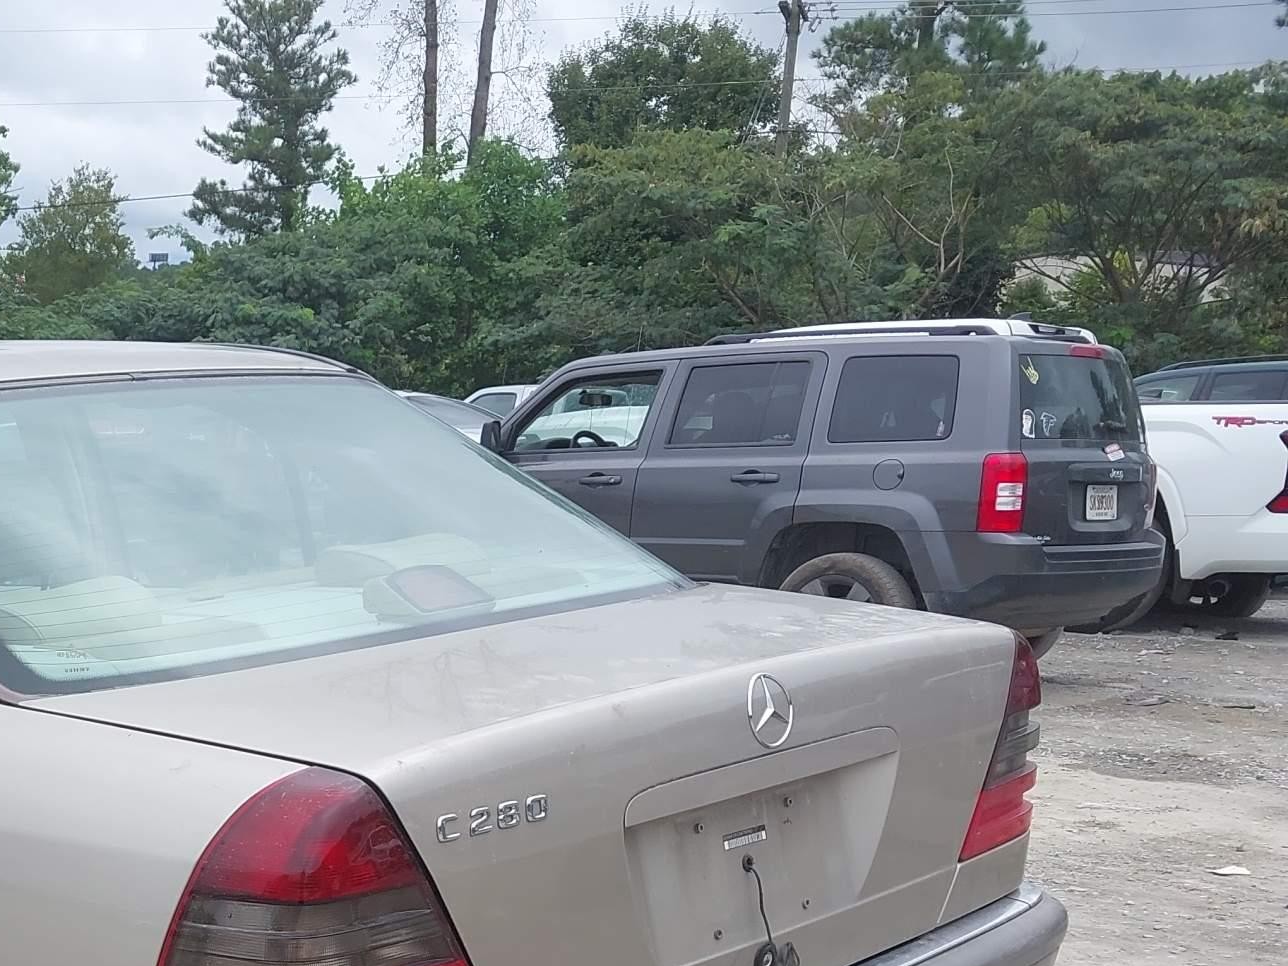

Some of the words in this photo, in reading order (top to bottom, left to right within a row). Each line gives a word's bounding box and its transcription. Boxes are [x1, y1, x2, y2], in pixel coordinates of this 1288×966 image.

[1212, 416, 1257, 427] TRD
[436, 813, 461, 843] C
[469, 794, 549, 837] 280
